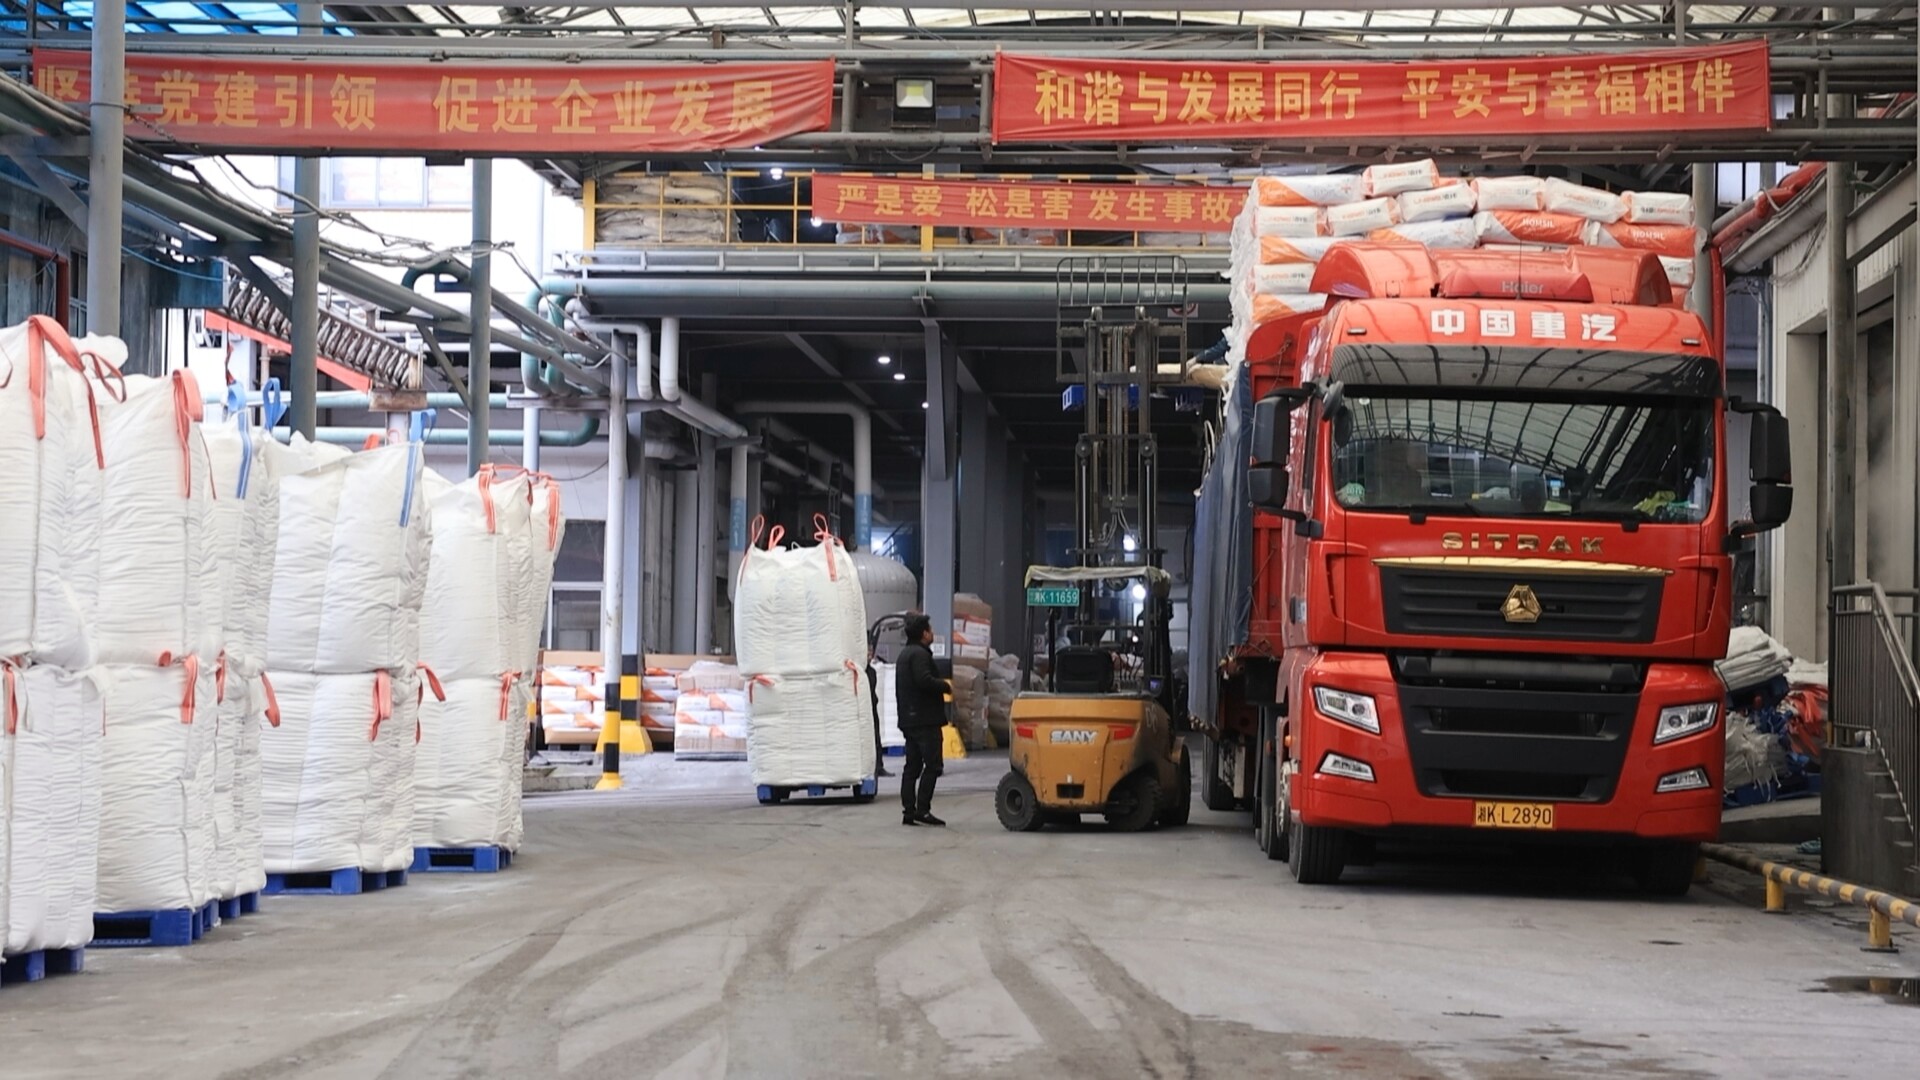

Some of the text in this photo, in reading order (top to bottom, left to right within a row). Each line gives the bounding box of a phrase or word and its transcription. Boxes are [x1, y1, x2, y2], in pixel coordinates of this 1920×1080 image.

[433, 75, 774, 136] 促进企业发展
[1035, 58, 1736, 125] 和谐与发展同行 平安与幸福相伴
[836, 183, 1247, 223] 严是爱 松是害 发生事故
[1502, 281, 1544, 294] Haier
[1430, 308, 1617, 341] 中国重汽
[1051, 729, 1098, 744] SANY
